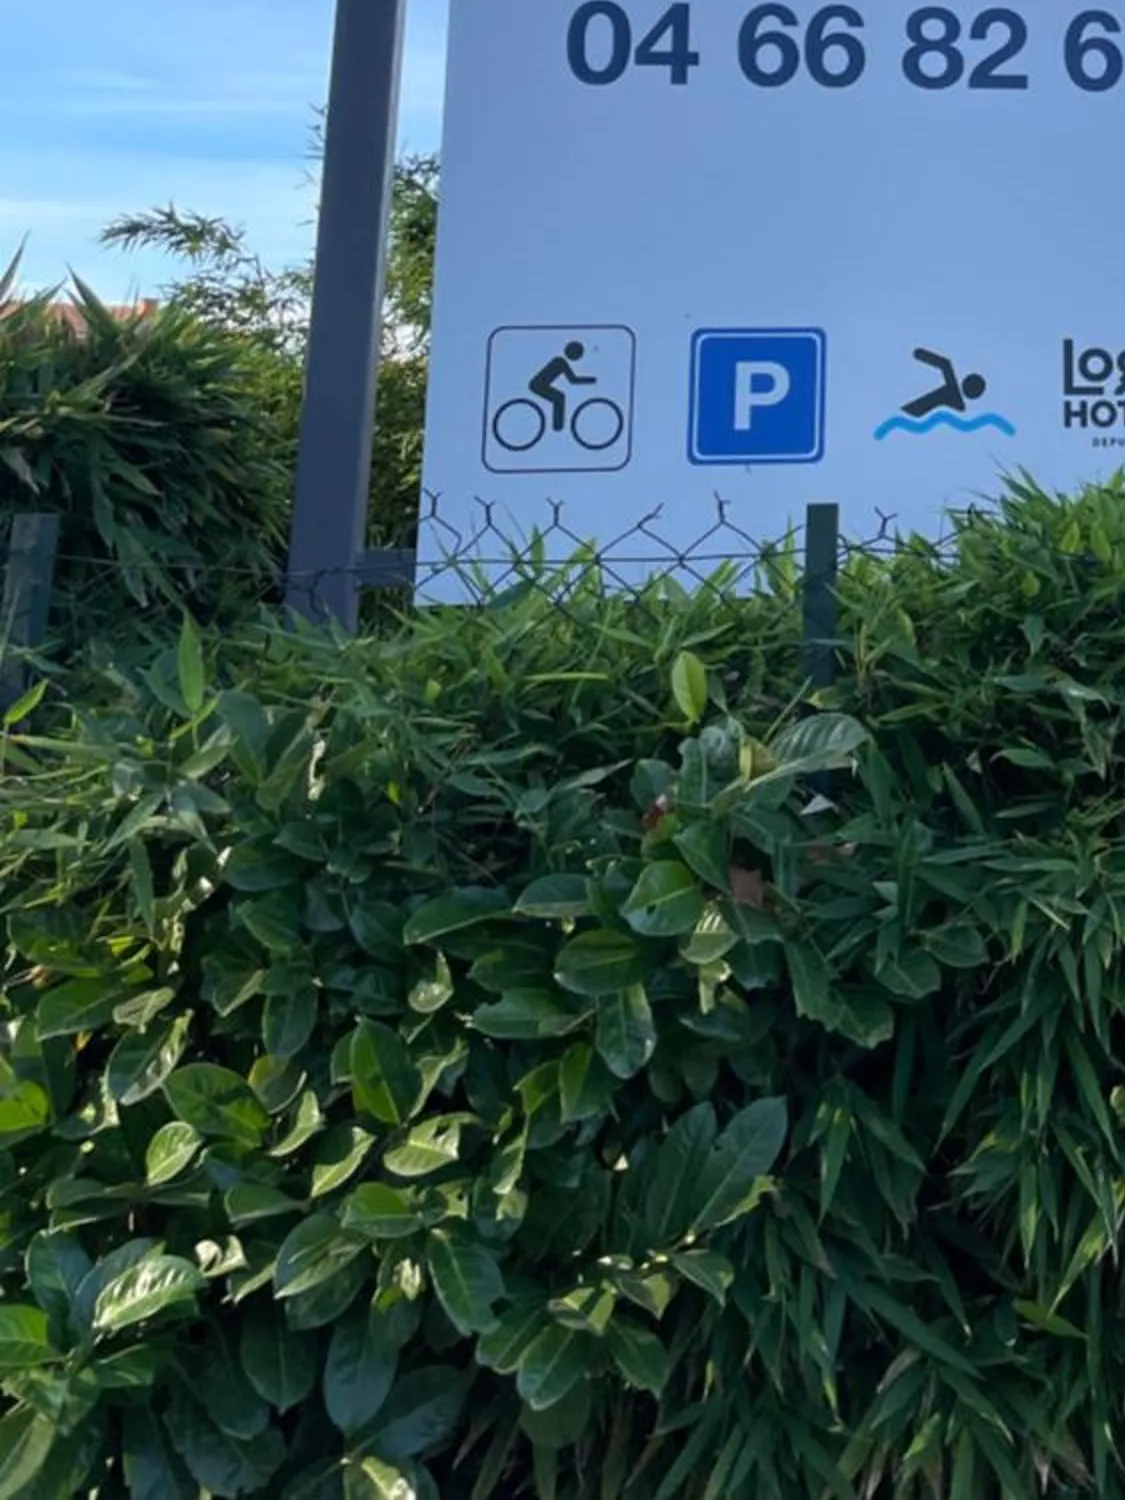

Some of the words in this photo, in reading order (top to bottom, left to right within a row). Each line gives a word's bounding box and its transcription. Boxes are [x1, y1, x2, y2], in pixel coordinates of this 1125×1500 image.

[565, 0, 701, 87] 04
[736, 2, 867, 89] 66
[901, 6, 1029, 91] 82
[734, 361, 791, 431] P
